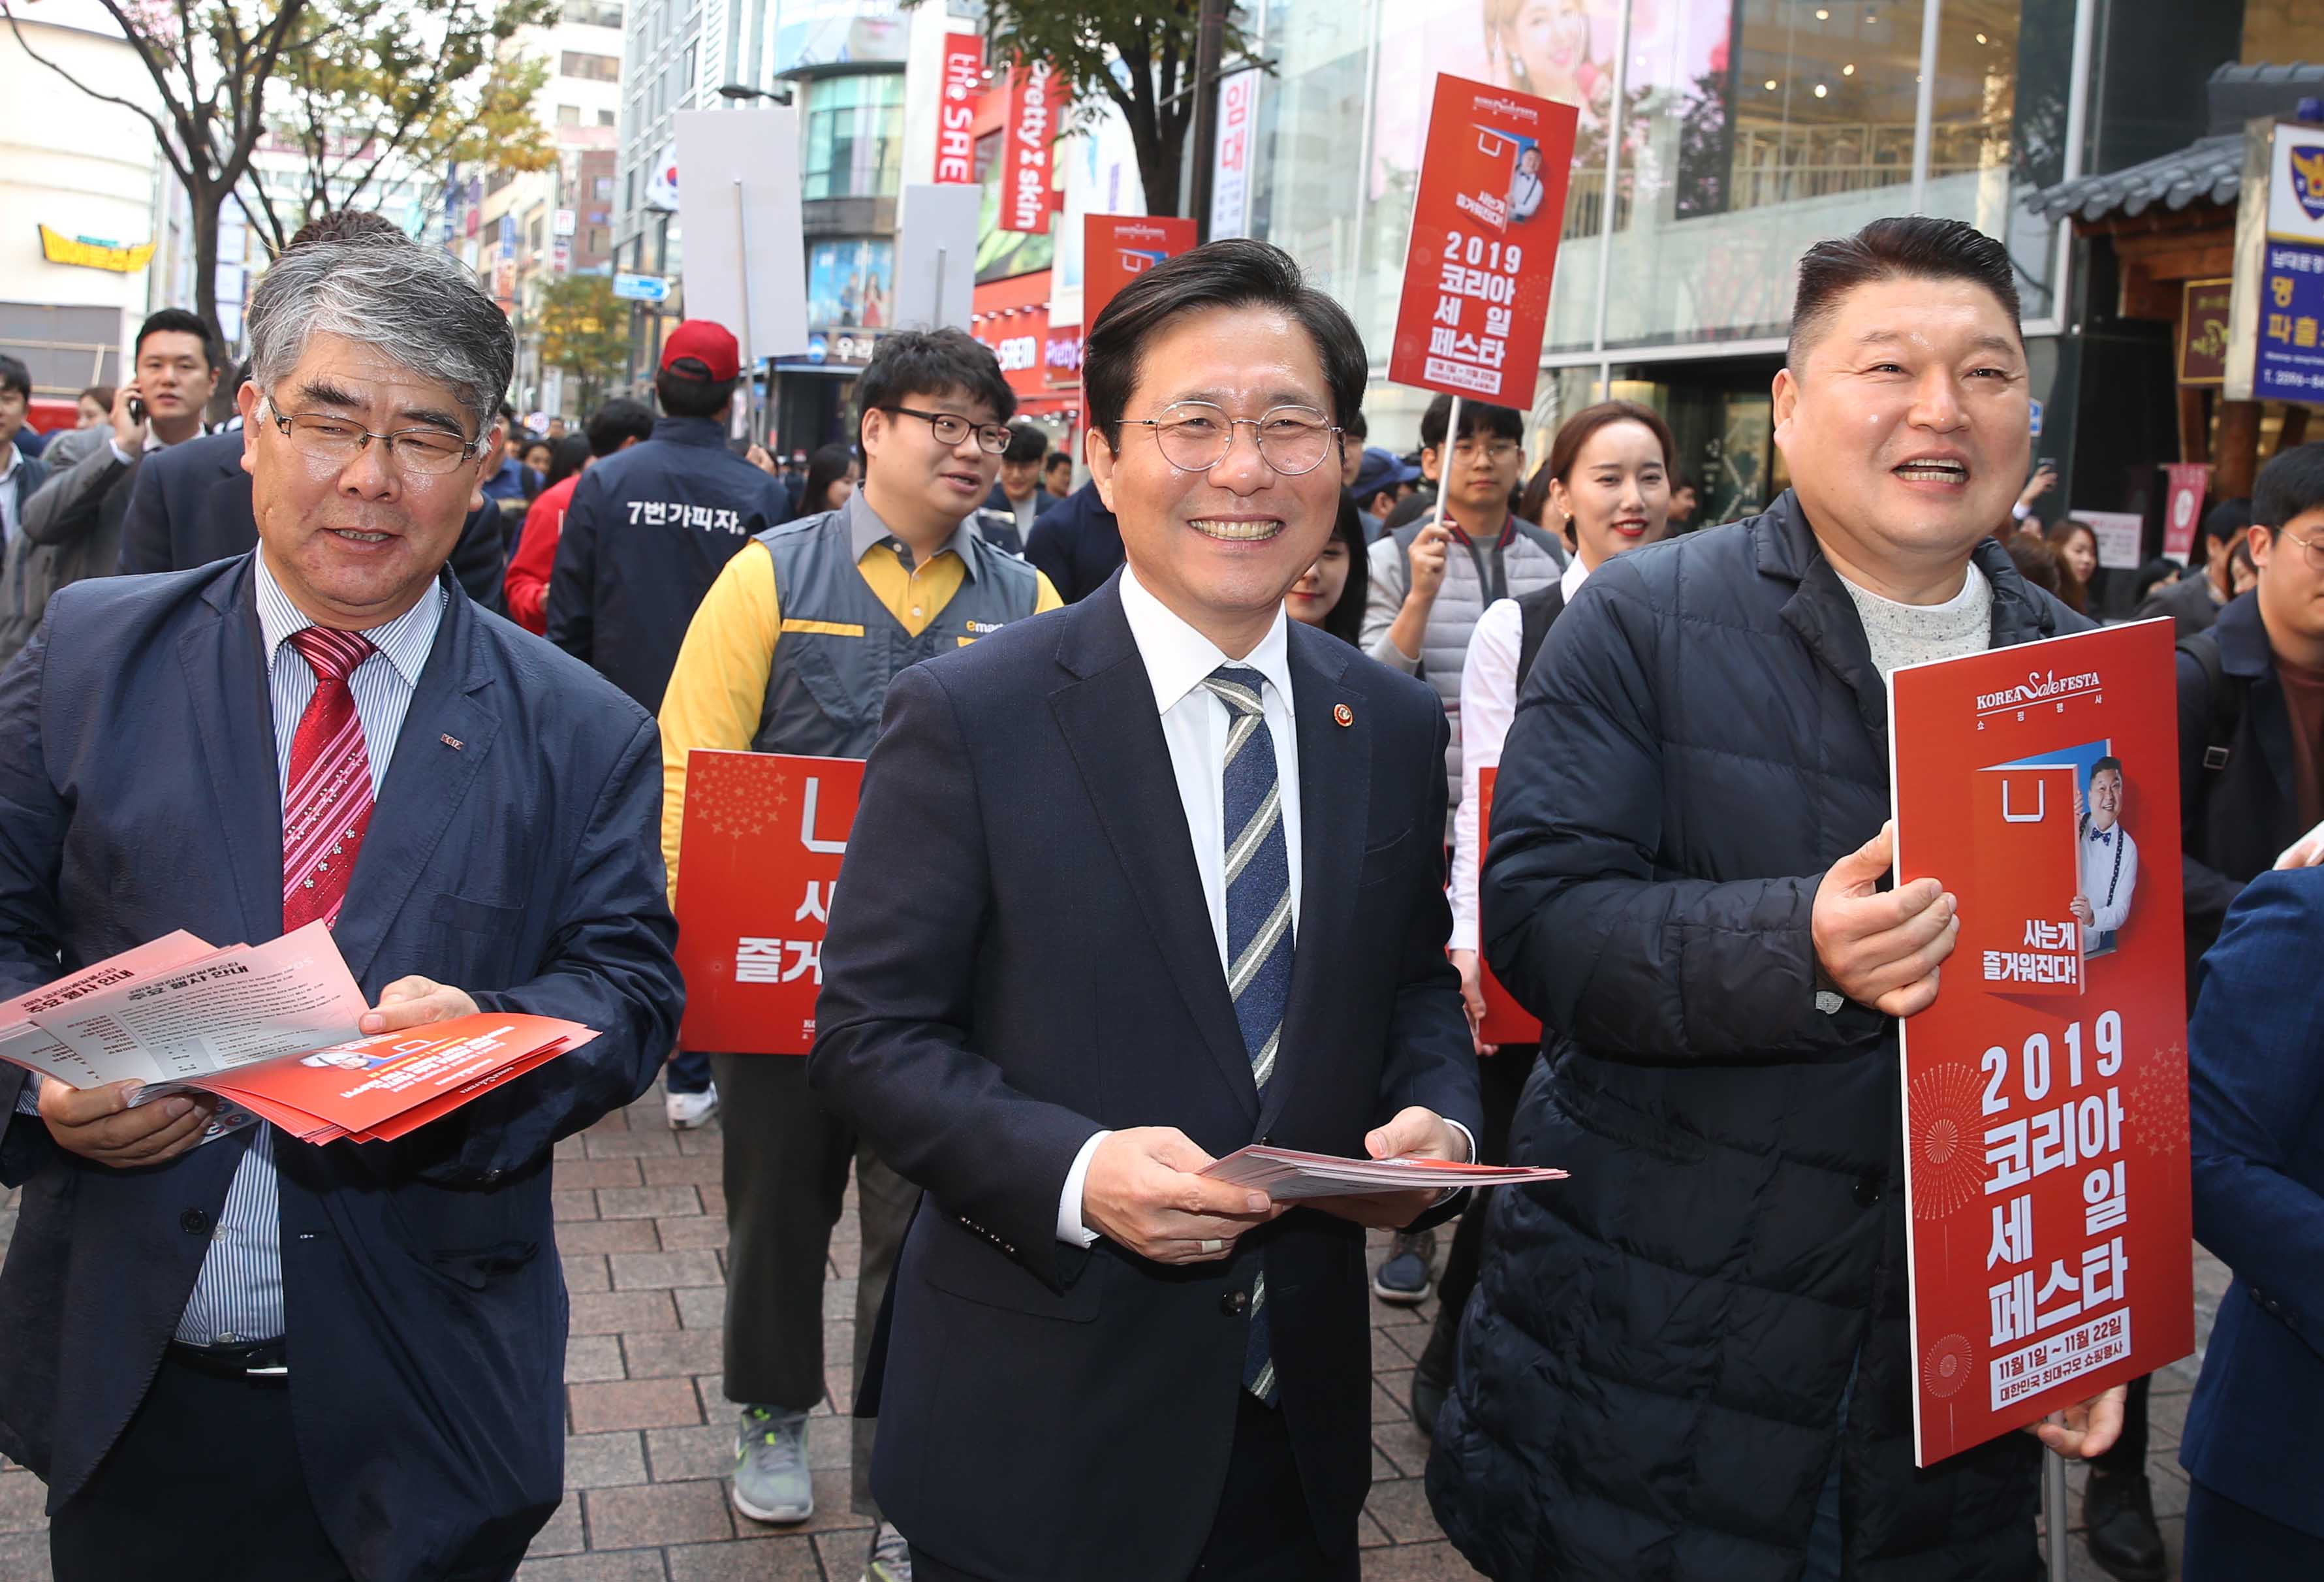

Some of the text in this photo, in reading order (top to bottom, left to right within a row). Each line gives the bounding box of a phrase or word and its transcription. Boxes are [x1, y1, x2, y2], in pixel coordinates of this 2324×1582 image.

[939, 105, 973, 183] SAE
[1015, 168, 1044, 229] skin
[1443, 231, 1522, 274] 2019
[1438, 262, 1516, 306] 코리아
[1428, 326, 1506, 368] 페스타
[1977, 687, 2022, 710] KOREA
[2059, 672, 2100, 692] FESTA
[2024, 919, 2075, 951] 사는게
[97, 970, 135, 986] 안내
[212, 965, 249, 979] 안내
[1983, 950, 2077, 985] 즐거워진다!
[1981, 1009, 2123, 1116] 2019
[1983, 1086, 2124, 1195] 코리아
[1989, 1235, 2128, 1348] 페스타
[1999, 1355, 2024, 1380] 11월
[2028, 1345, 2047, 1368] 1일
[2065, 1329, 2089, 1353] 11월
[2093, 1316, 2122, 1342] 22일
[2000, 1340, 2123, 1402] 대한민국 최대규모 쇼핑행사
